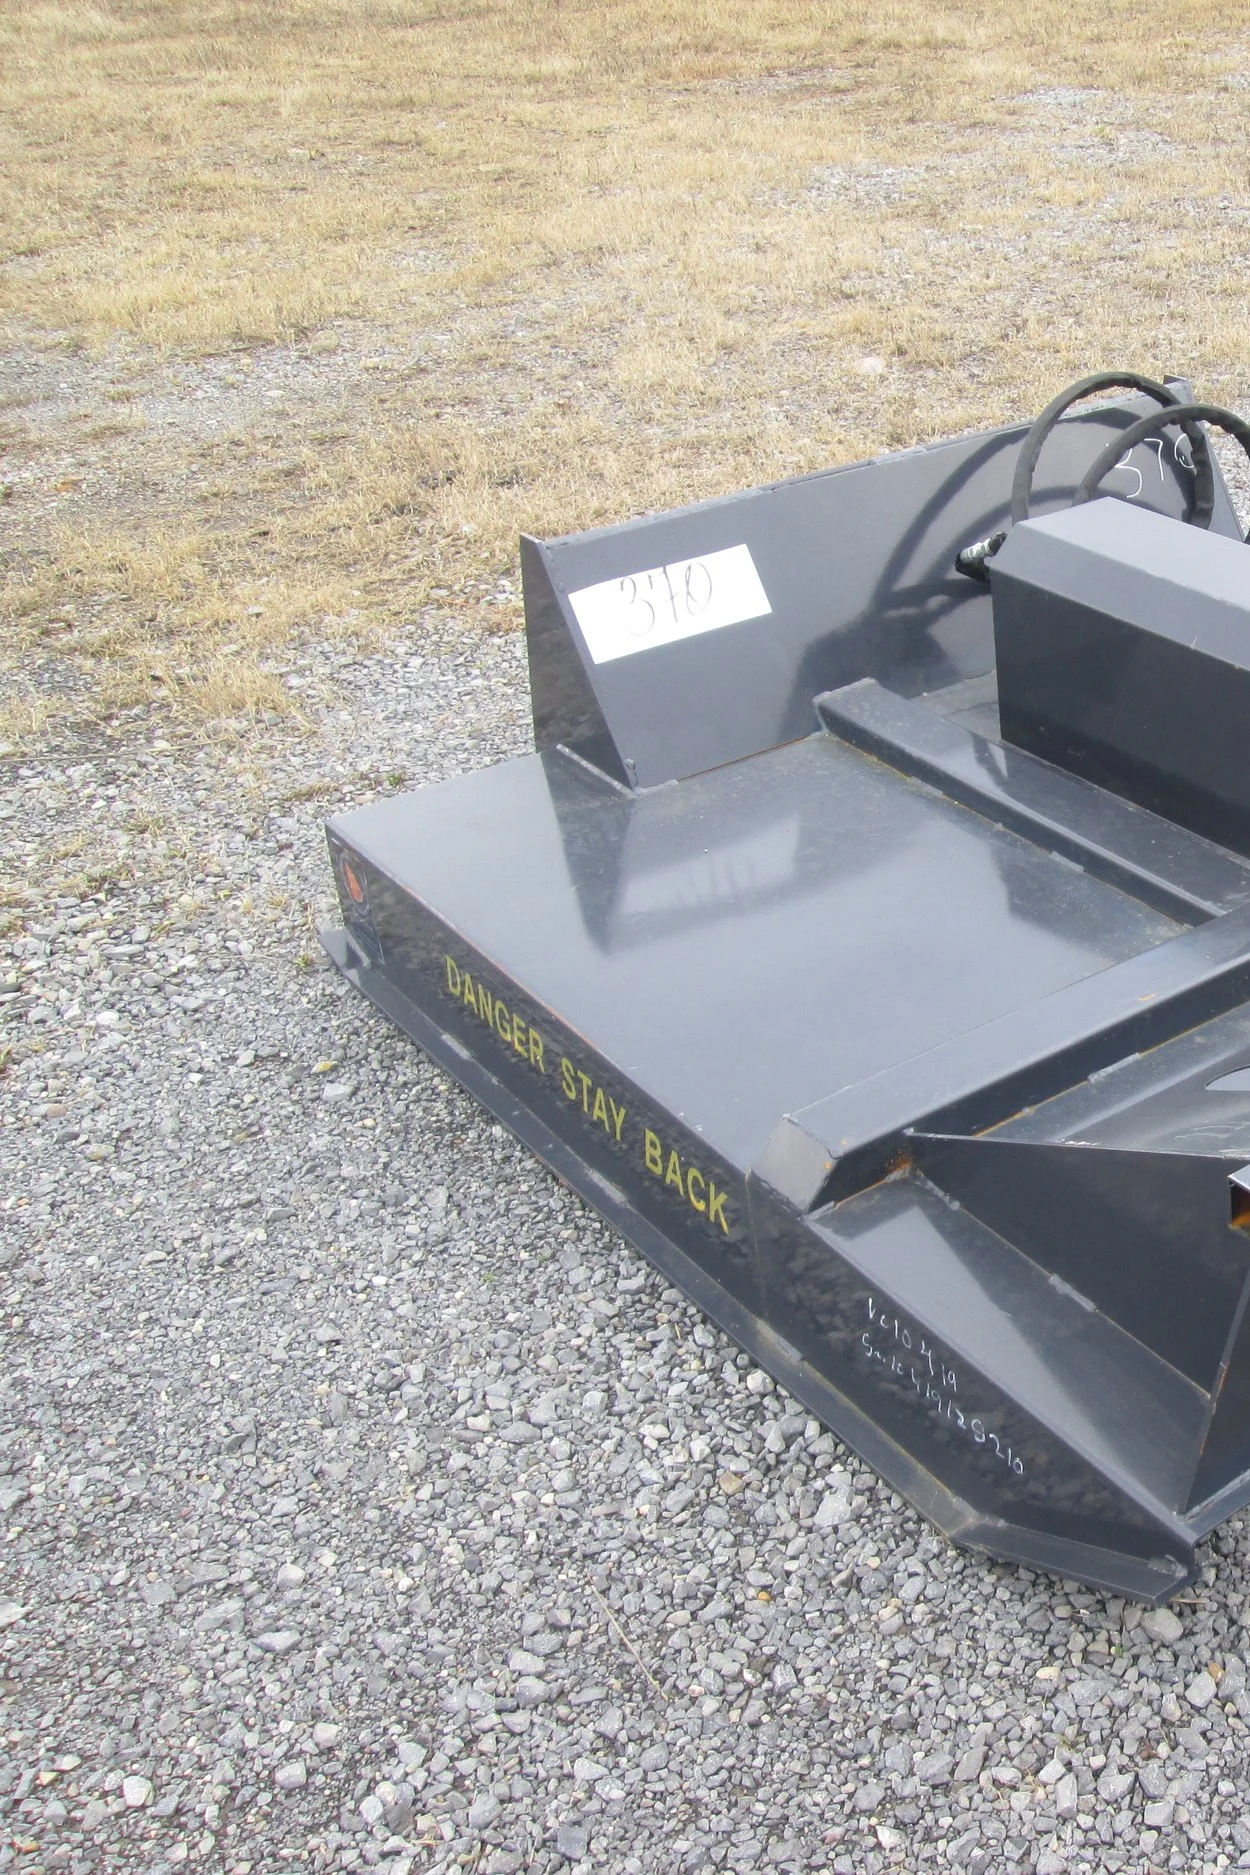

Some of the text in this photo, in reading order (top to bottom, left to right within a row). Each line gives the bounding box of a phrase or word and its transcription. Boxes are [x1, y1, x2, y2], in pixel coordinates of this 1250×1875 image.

[620, 561, 713, 637] 370
[445, 954, 730, 1237] DANGER STAY BACK
